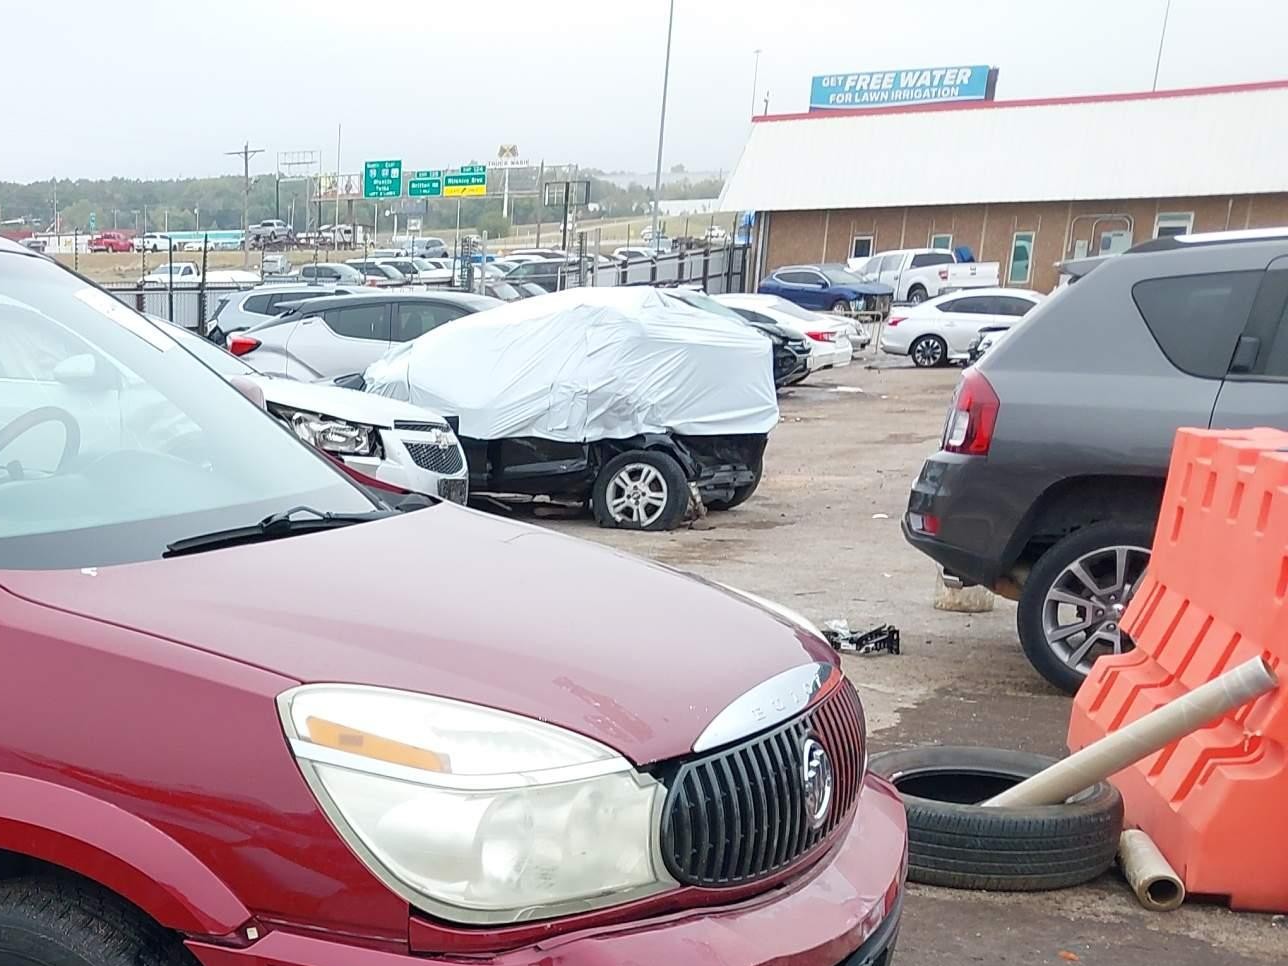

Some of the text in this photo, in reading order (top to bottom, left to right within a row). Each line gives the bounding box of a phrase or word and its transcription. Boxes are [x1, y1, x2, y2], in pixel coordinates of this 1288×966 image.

[822, 67, 972, 91] GET FREE WATER
[829, 86, 960, 105] FOR LAWN IRRIGATION
